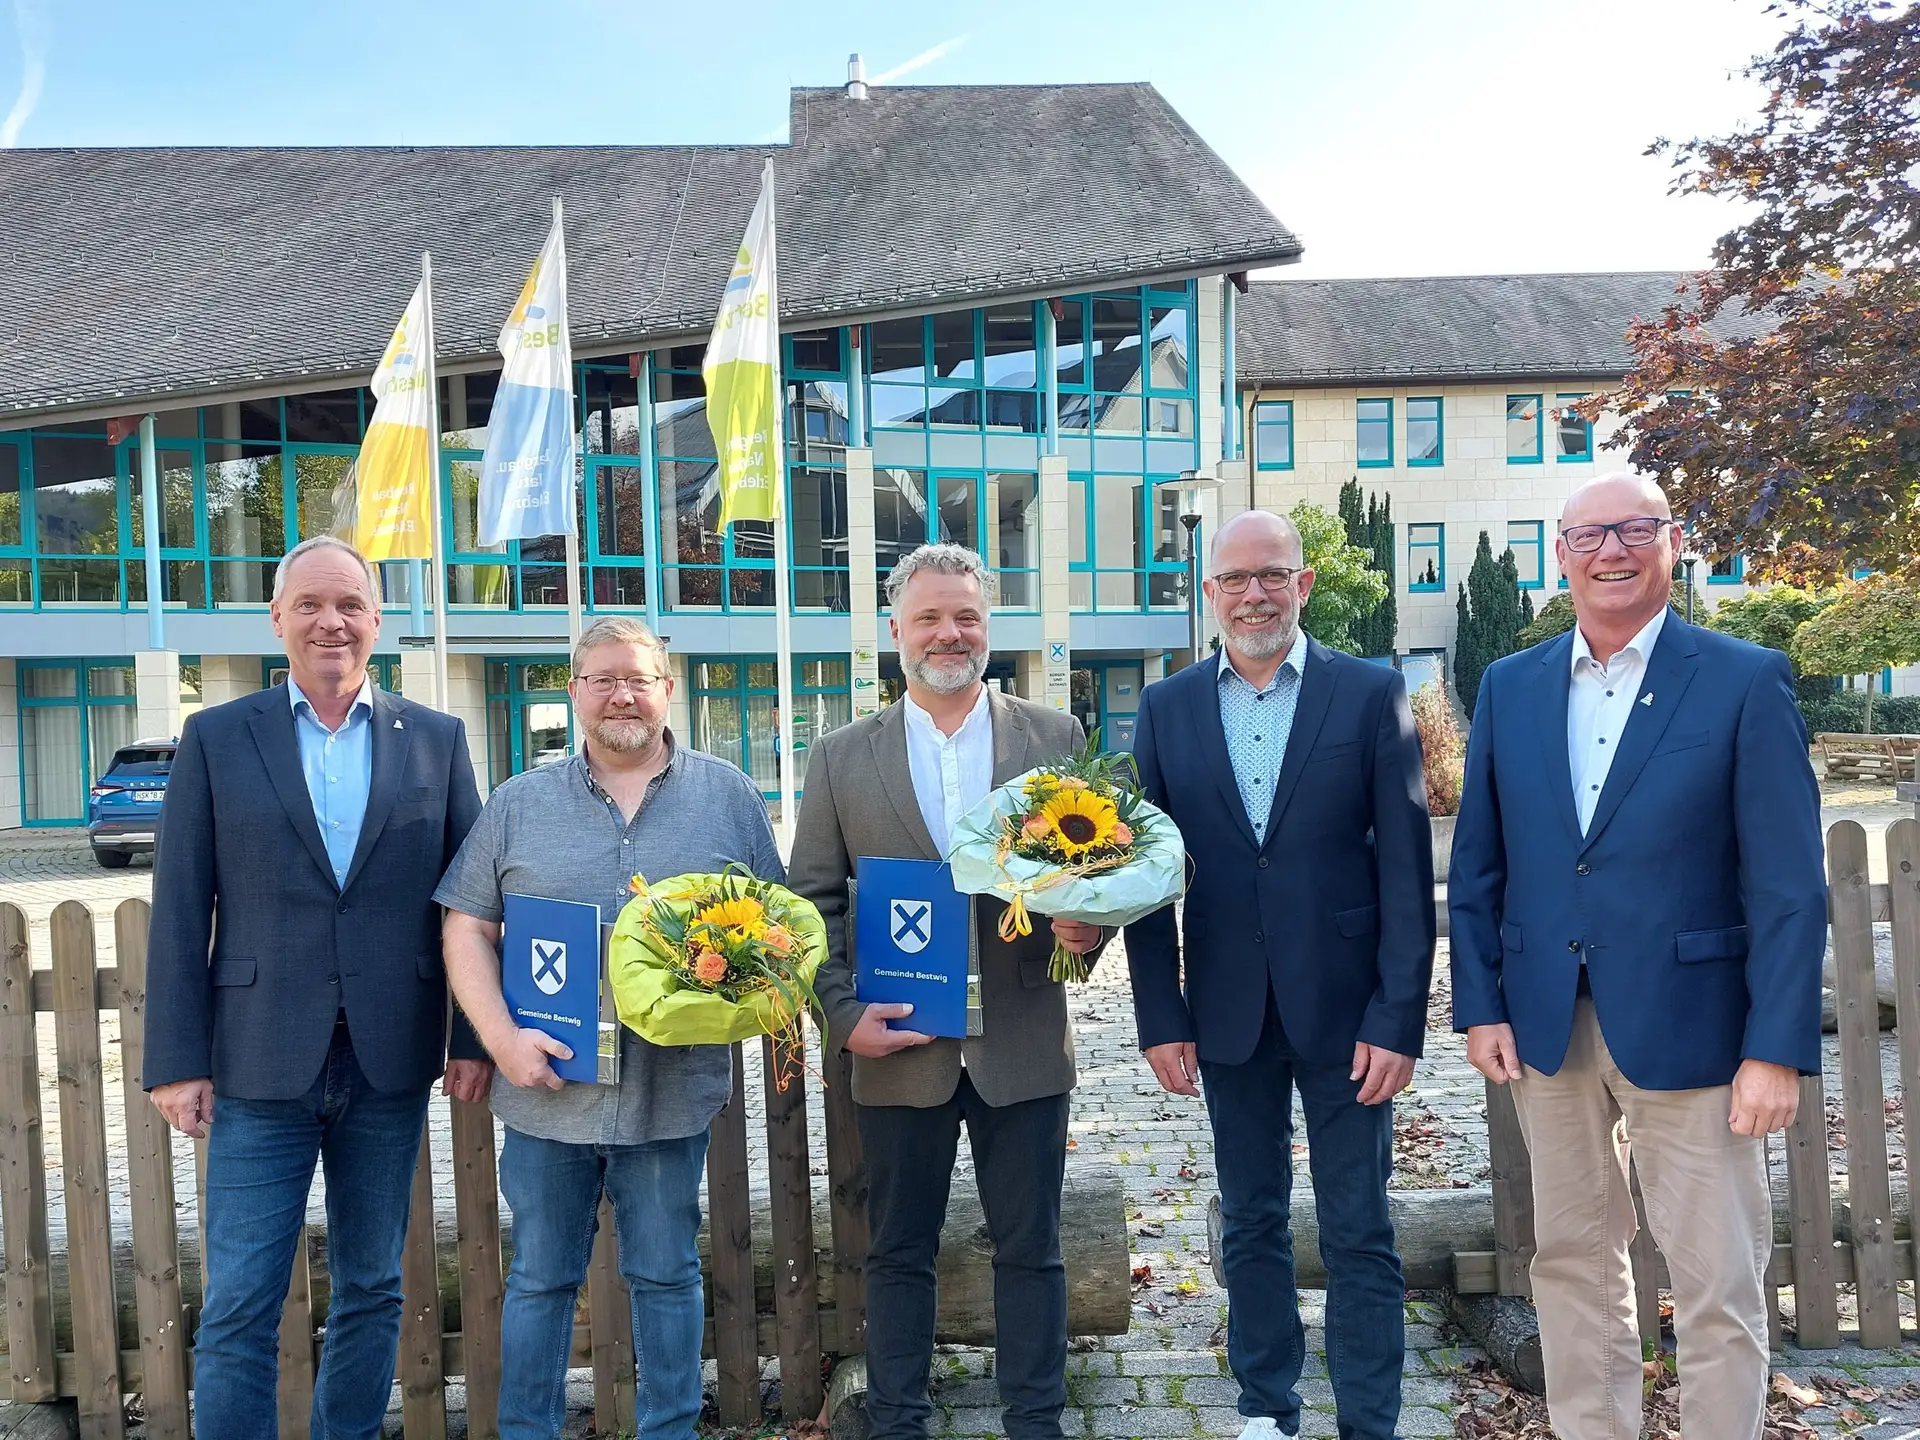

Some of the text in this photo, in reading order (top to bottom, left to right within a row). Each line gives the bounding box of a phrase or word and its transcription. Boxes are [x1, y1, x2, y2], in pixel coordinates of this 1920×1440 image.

[874, 968, 948, 984] Gemeinde Bestwig
[517, 1007, 582, 1027] Gemeinde Bestwig
